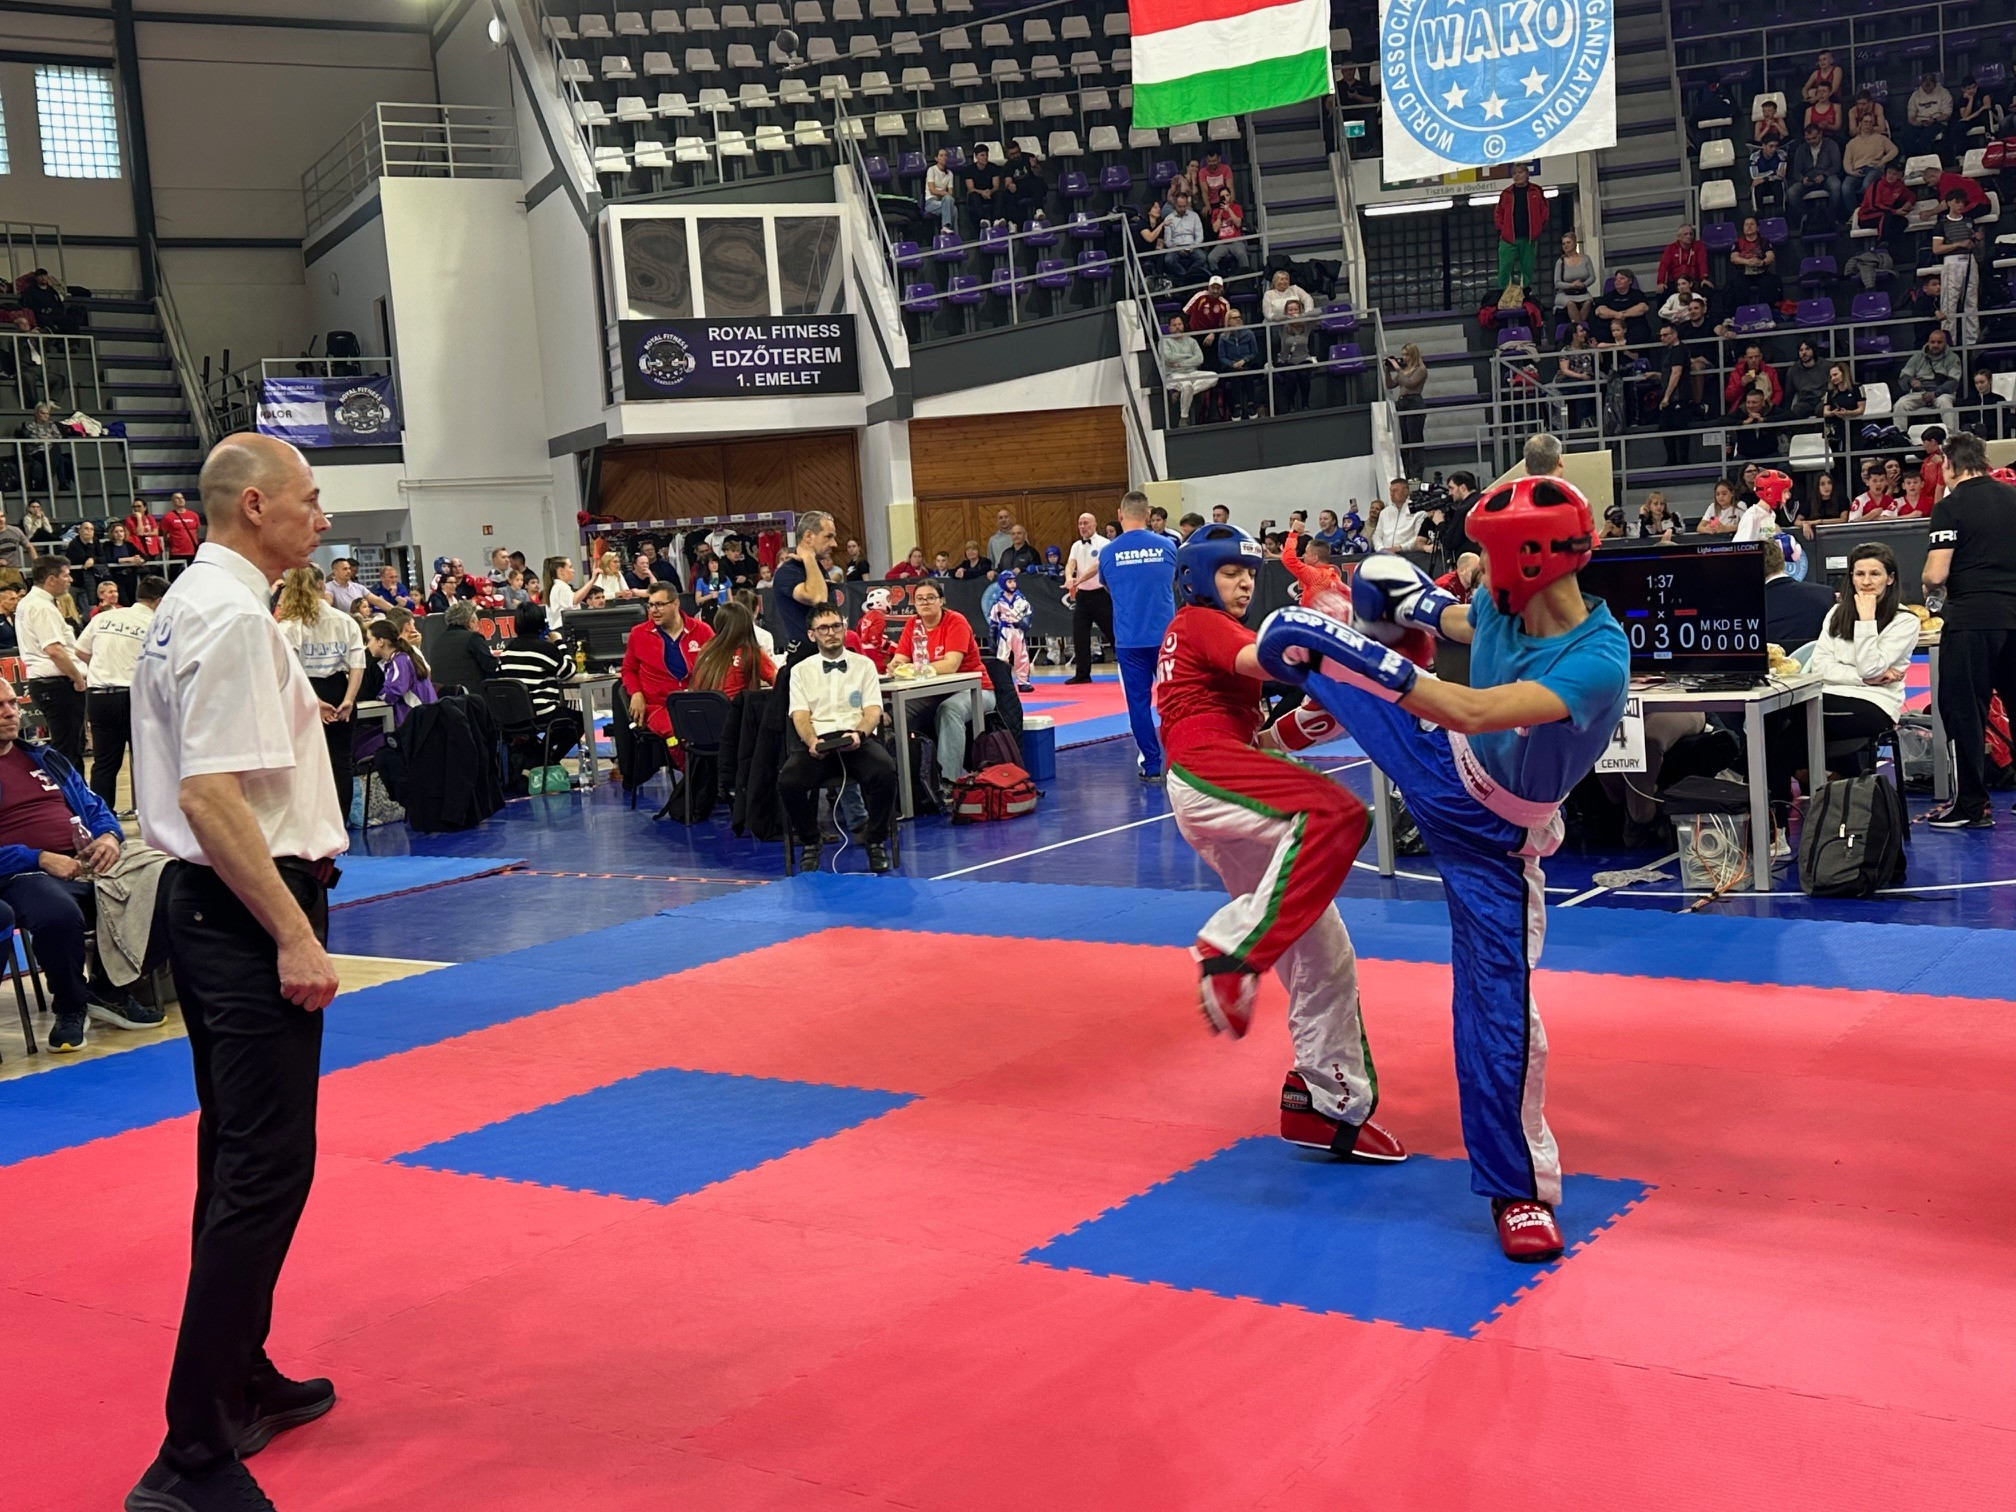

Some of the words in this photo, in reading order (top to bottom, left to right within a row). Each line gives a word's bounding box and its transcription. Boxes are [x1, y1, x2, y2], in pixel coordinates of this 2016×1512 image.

[1420, 0, 1574, 71] WAKO
[1398, 92, 1455, 153] WORLD
[708, 326, 767, 341] ROYAL
[771, 324, 841, 339] FITNESS
[711, 345, 842, 367] EDZŐTEREM
[736, 374, 750, 387] 1.
[755, 371, 821, 387] EMELET
[1646, 574, 1674, 589] 1:37
[1658, 591, 1665, 604] 1
[1280, 611, 1324, 628] TOP
[1324, 620, 1365, 652] TEN
[1700, 620, 1711, 631] M
[1734, 619, 1742, 630] E
[1747, 618, 1759, 630] W
[1630, 623, 1646, 649] 0
[1654, 623, 1670, 649] 3
[1679, 622, 1695, 648] 0
[1612, 720, 1627, 749] 4
[1601, 759, 1640, 769] CENTURY
